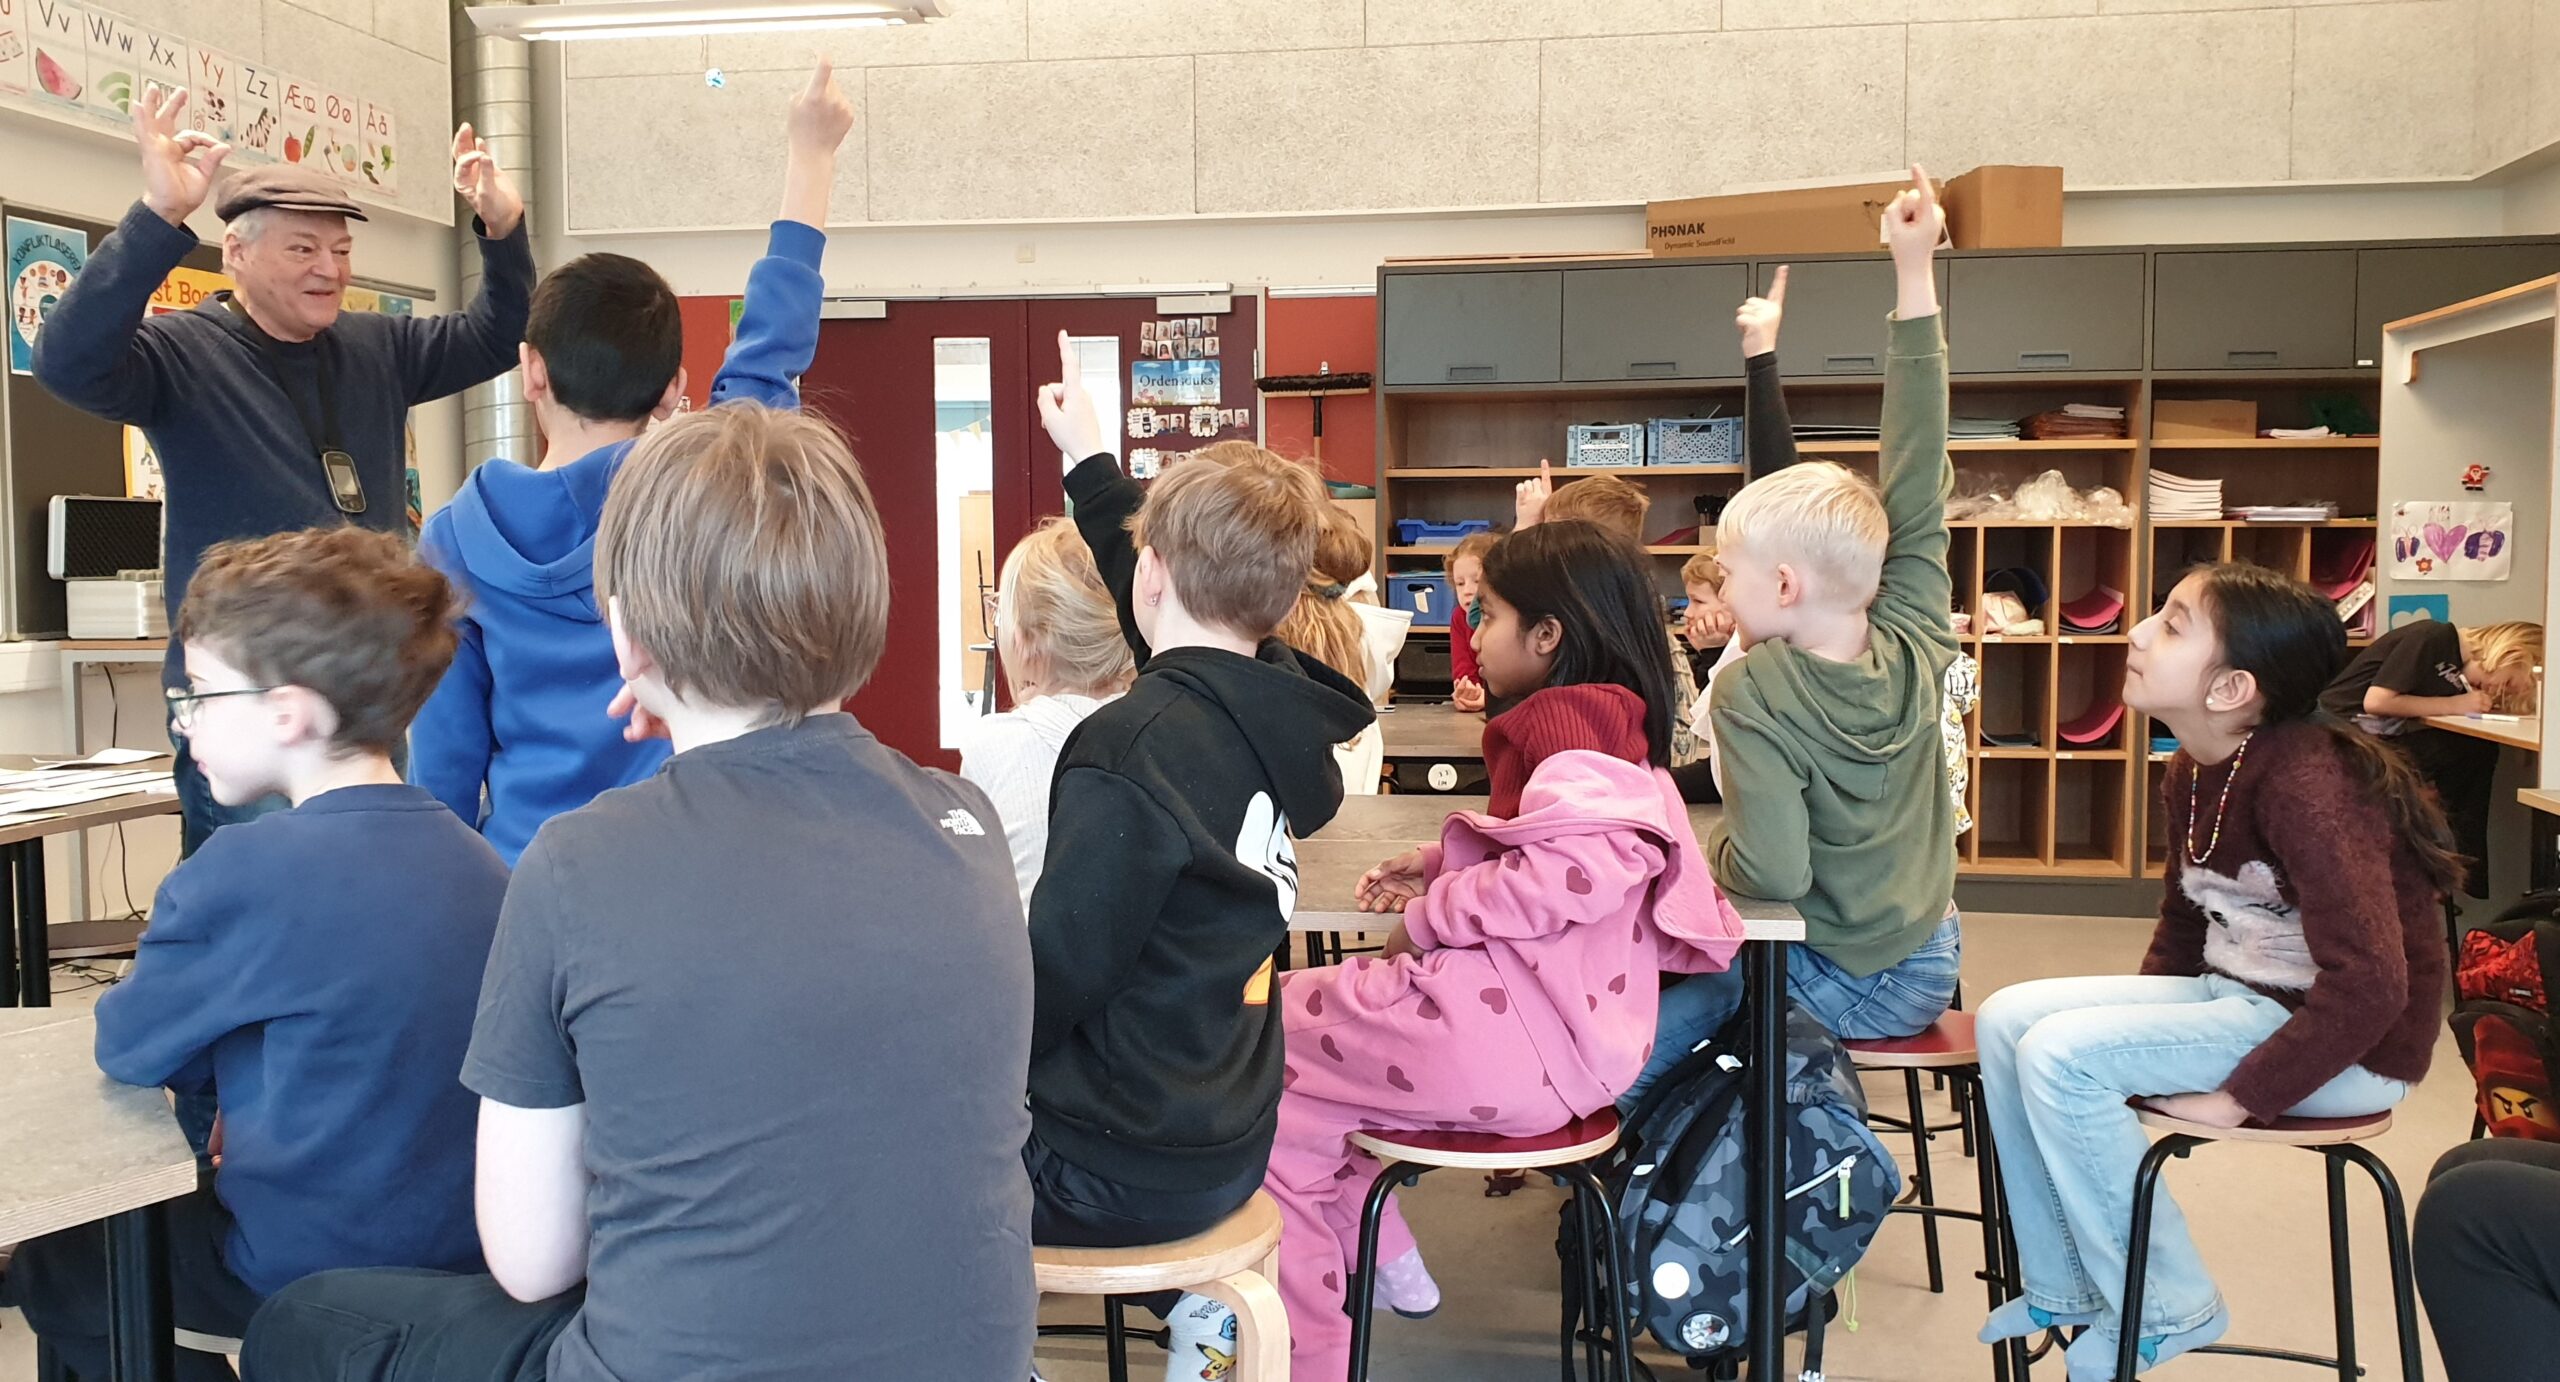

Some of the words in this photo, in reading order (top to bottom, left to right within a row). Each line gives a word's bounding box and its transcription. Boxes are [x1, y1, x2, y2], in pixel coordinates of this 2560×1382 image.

[199, 50, 224, 87] Yy
[245, 67, 269, 99] Zz
[1651, 222, 1705, 238] PHONAK
[939, 817, 970, 829] NORTH
